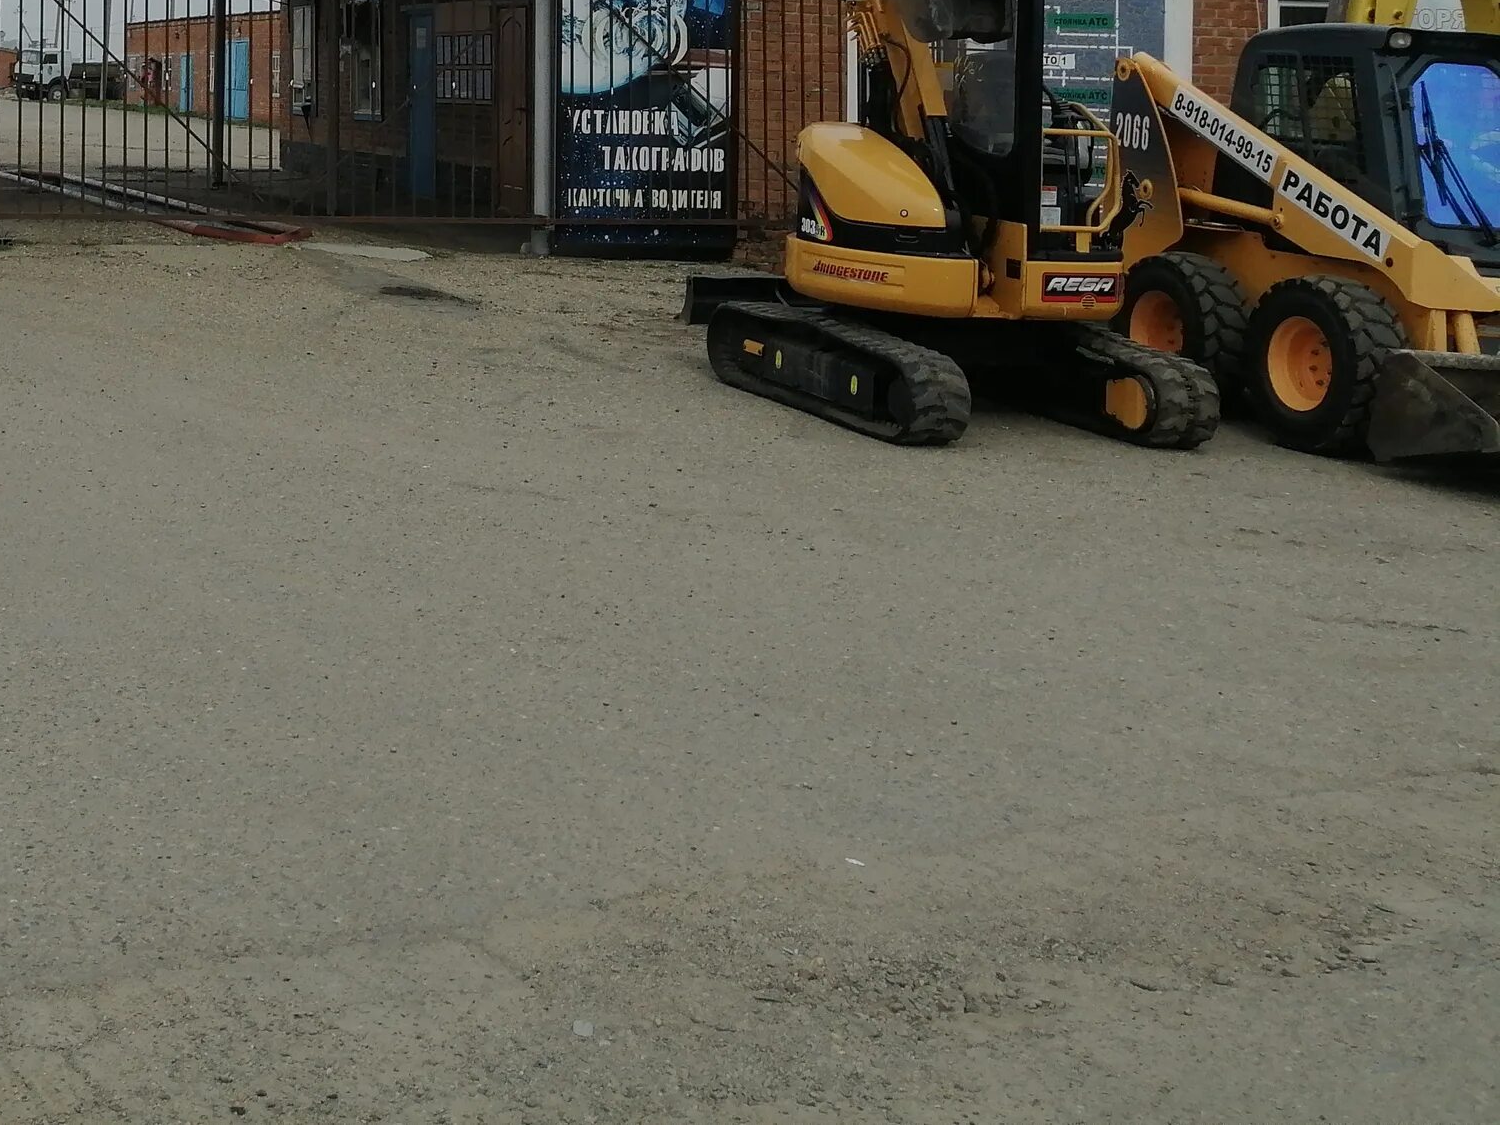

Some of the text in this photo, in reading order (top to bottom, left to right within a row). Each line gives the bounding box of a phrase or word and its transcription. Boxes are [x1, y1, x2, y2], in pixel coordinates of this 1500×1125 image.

[1088, 17, 1109, 27] АТС
[1116, 112, 1149, 151] 2066
[1174, 93, 1274, 174] 8-918-014-99-15
[1282, 170, 1381, 257] РАБОТА
[813, 260, 889, 282] BRIDGESTONE
